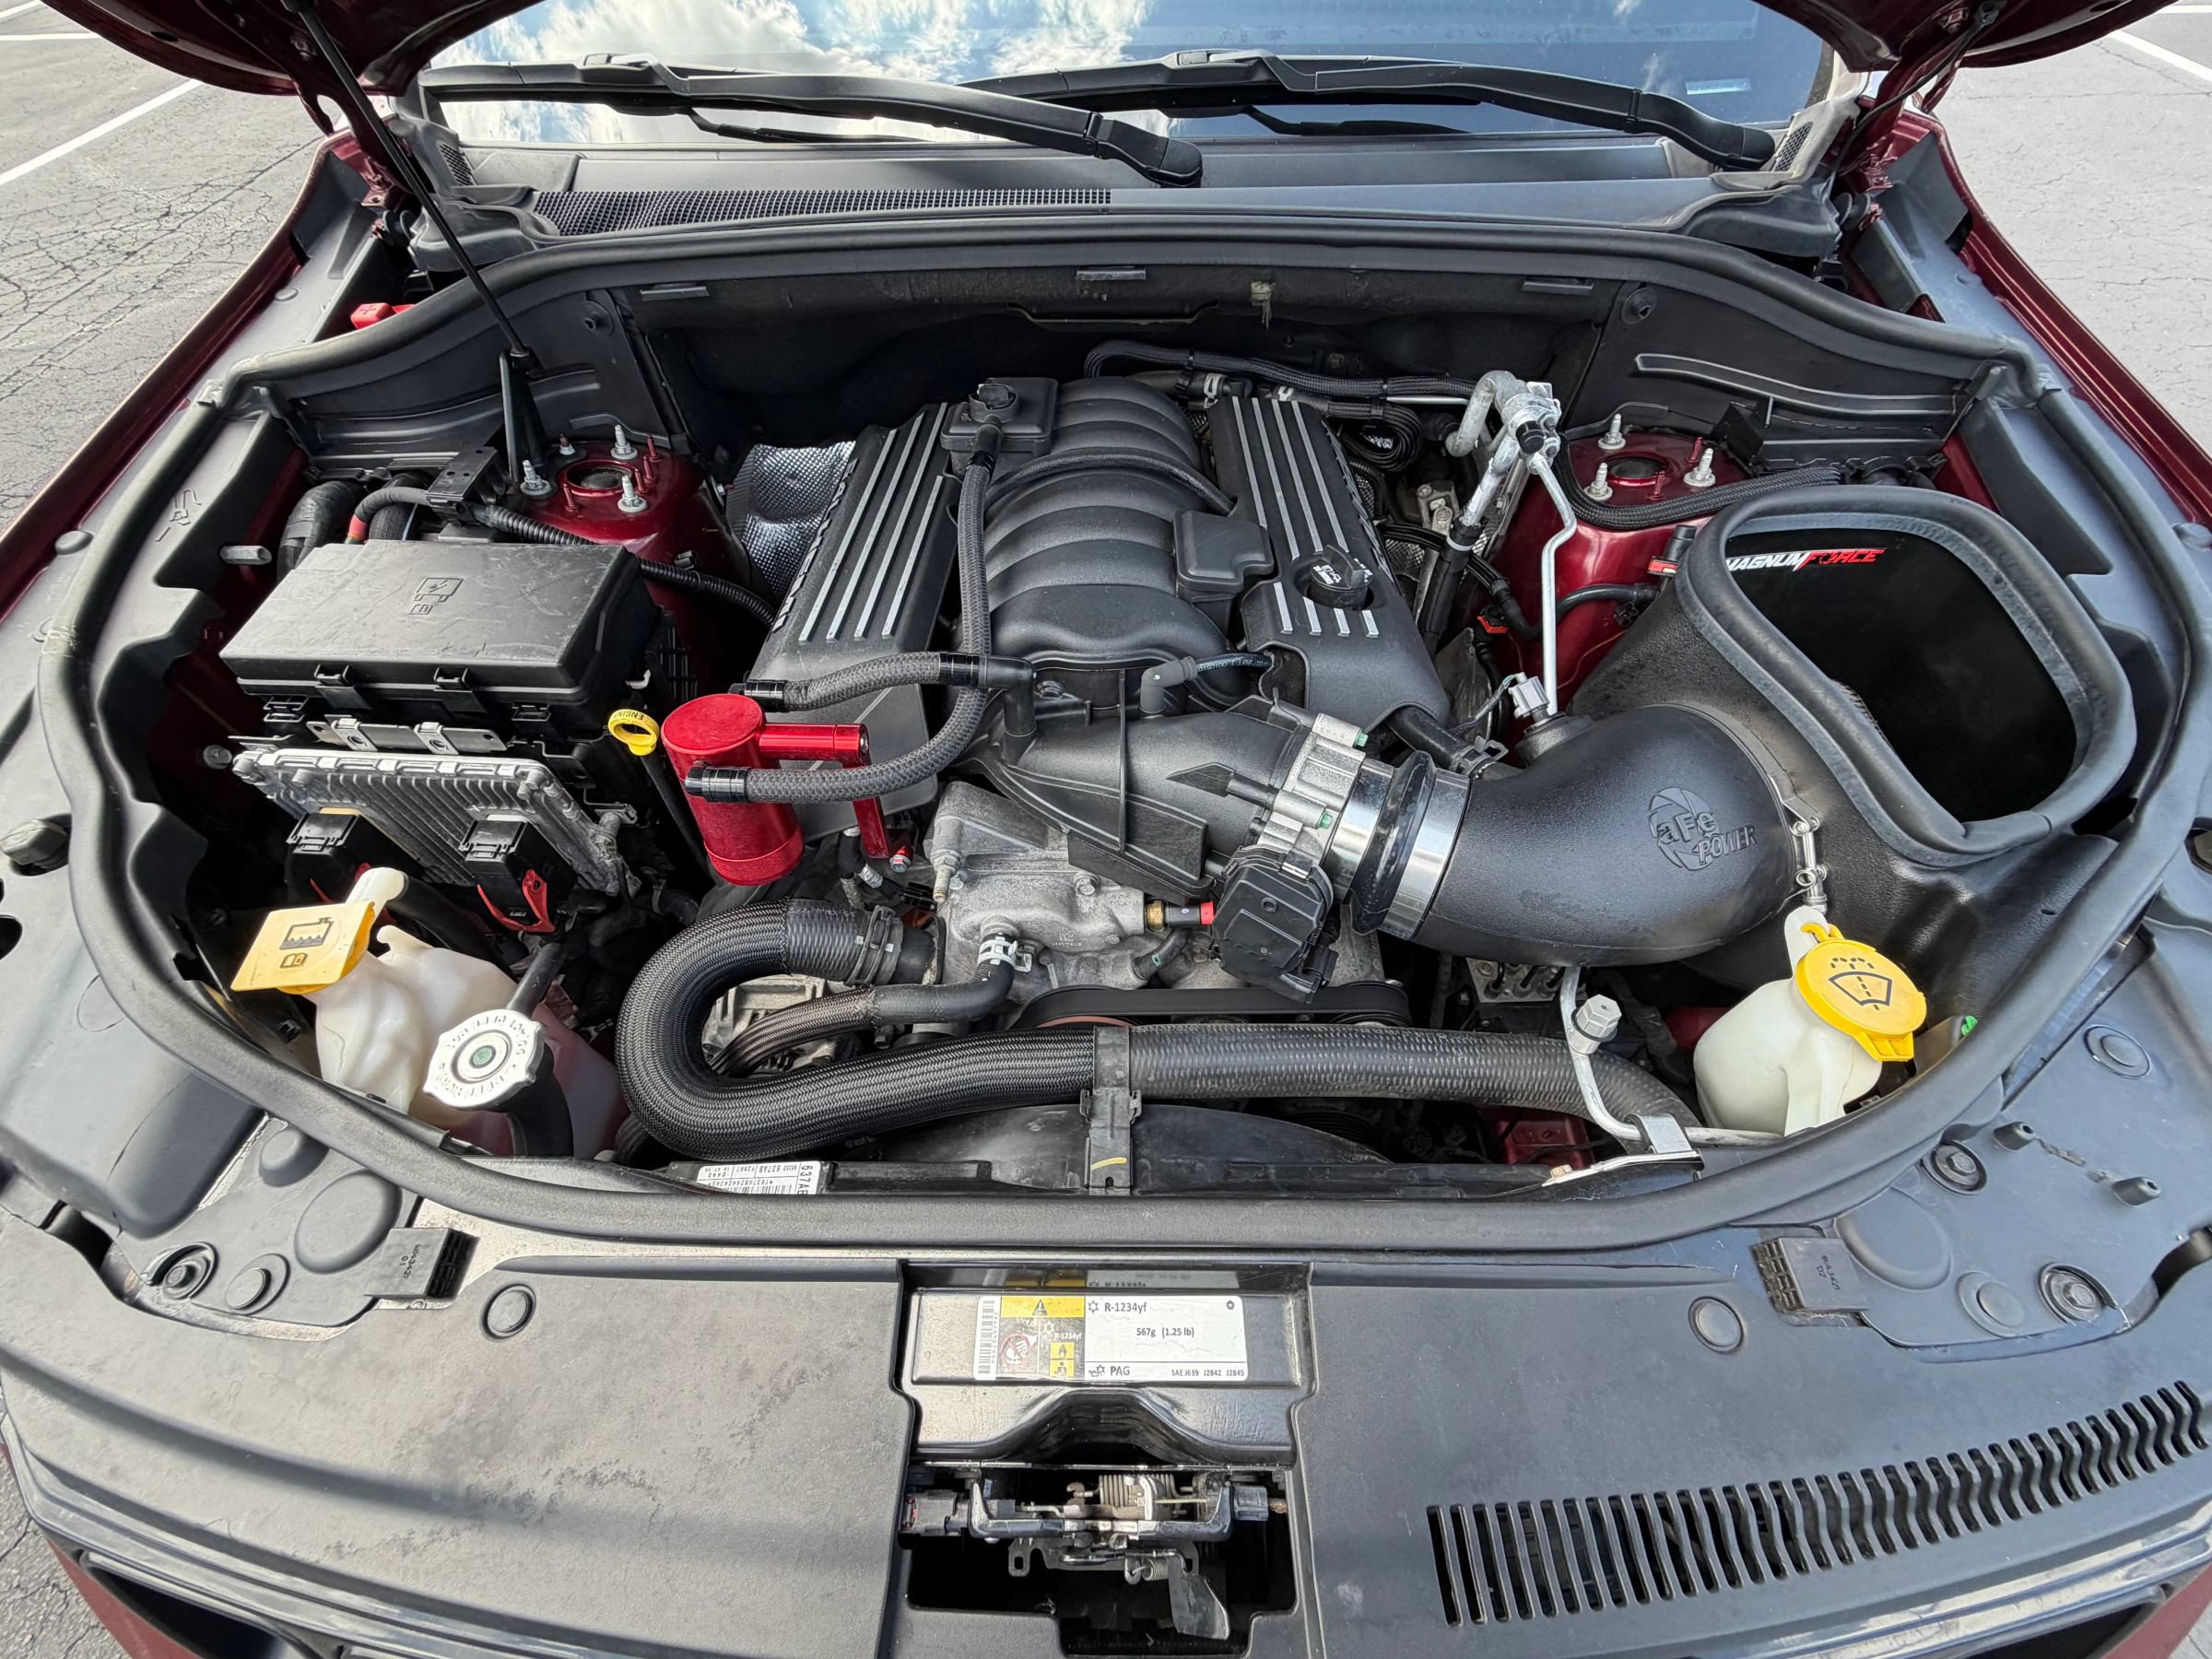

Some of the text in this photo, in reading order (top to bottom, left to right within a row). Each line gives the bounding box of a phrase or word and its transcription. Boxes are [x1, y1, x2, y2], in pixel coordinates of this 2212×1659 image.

[1656, 811, 1717, 845] aFe
[1698, 825, 1757, 864] POWER
[1104, 1301, 1147, 1313] R-1234yf
[1136, 1327, 1195, 1337] 567g (1.25 lb)
[1110, 1366, 1131, 1377] PAG
[1171, 1369, 1245, 1377] SAE J639 J2842 J2845
